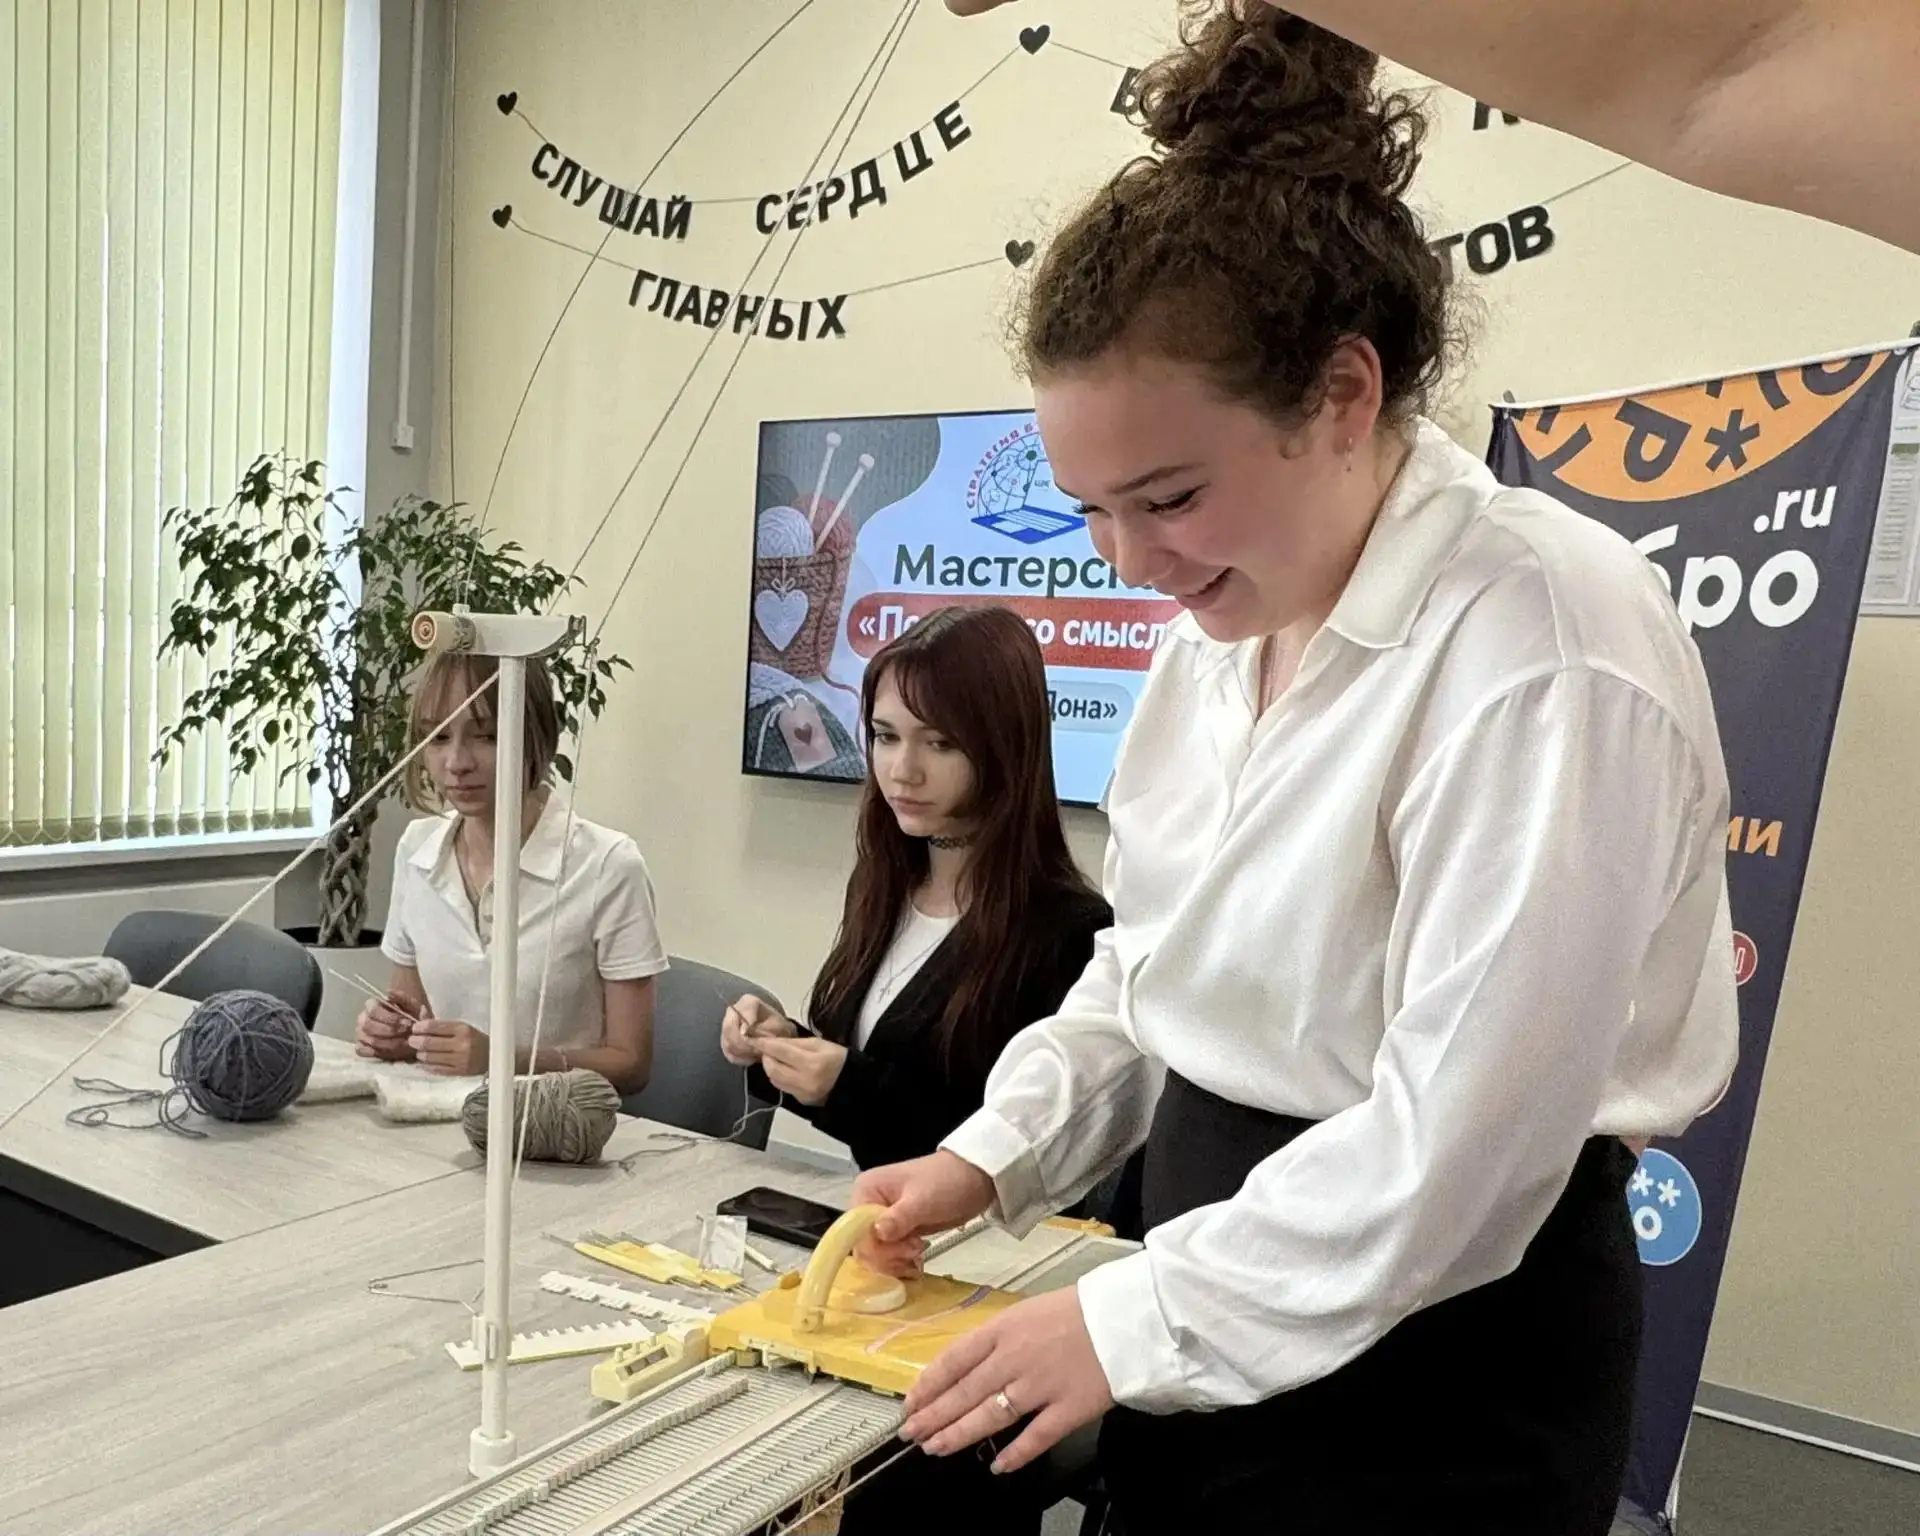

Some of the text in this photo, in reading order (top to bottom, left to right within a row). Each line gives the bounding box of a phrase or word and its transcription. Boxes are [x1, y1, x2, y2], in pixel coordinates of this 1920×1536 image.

[531, 143, 692, 241] СЛУШАЙ
[756, 100, 971, 235] СЕРДЦЕ
[628, 269, 848, 341] ГЛАВНЫХ
[1753, 486, 1837, 533] .ru
